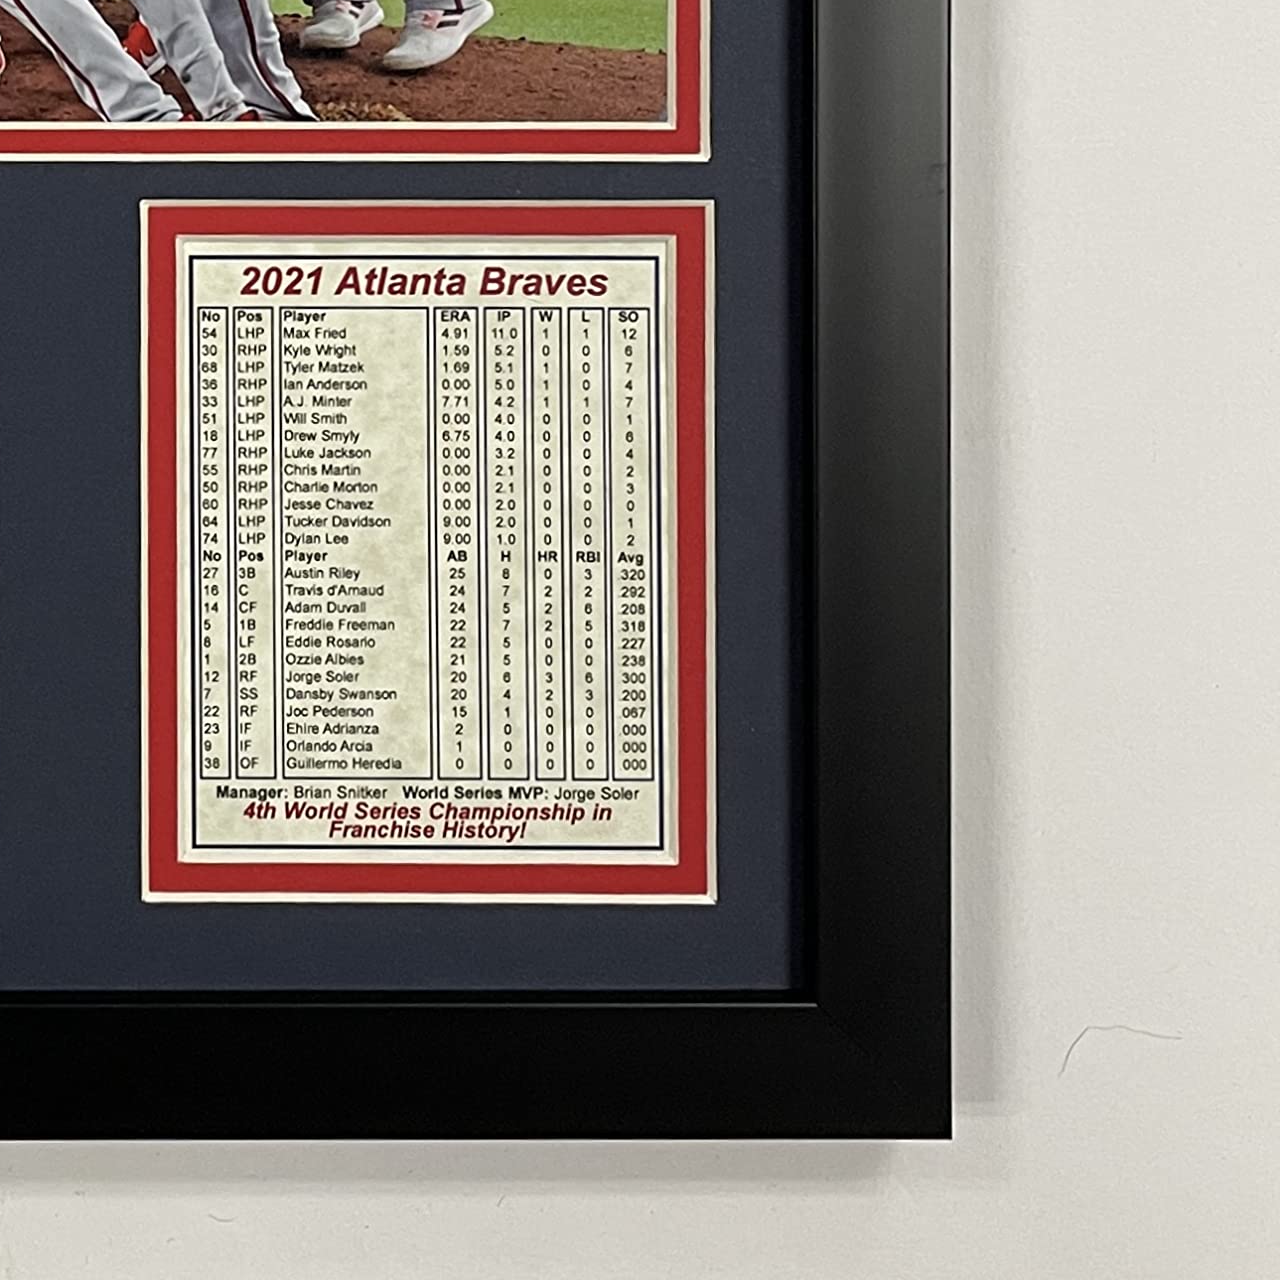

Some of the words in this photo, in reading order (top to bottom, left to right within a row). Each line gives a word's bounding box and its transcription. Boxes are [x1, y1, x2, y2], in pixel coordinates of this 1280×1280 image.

[240, 266, 323, 296] 2021
[333, 266, 467, 296] Atlanta
[479, 266, 609, 297] Braves
[201, 310, 221, 323] No
[237, 310, 263, 322] Pos
[283, 310, 327, 325] Player
[440, 309, 471, 323] ERA
[497, 310, 511, 322] IP
[538, 310, 554, 323] W
[581, 310, 591, 323] L
[618, 310, 639, 323] SO
[202, 327, 217, 339] 54
[237, 326, 265, 339] LHP
[283, 326, 310, 340] Max
[314, 327, 347, 340] Fried
[202, 344, 218, 357] 30
[237, 344, 267, 356] RHP
[283, 344, 311, 359] Kyle
[315, 344, 357, 359] Wright
[201, 361, 218, 373] 68
[237, 361, 265, 373] LHP
[283, 360, 315, 376] Tyler
[318, 360, 365, 374] Matzek
[202, 378, 218, 391] 36
[237, 378, 268, 390] RHP
[283, 378, 304, 391] Ian
[306, 378, 368, 391] Anderson
[202, 395, 218, 408] 33
[237, 395, 265, 408] LHP
[312, 395, 353, 408] Minter
[202, 412, 217, 425] 51
[237, 412, 266, 425] LHP
[283, 412, 307, 425] Will
[311, 412, 348, 425] Smith
[203, 429, 218, 442] 18
[237, 429, 265, 442] LHP
[283, 429, 318, 442] Drew
[321, 429, 360, 445] Smyly
[202, 446, 218, 459] 77
[237, 446, 268, 459] RHP
[284, 447, 315, 459] Luke
[318, 447, 372, 459] Jackson
[202, 464, 219, 476] 55
[237, 463, 268, 476] RHP
[284, 463, 318, 476] Chris
[321, 463, 361, 476] Martin
[202, 481, 219, 494] 50
[238, 480, 268, 493] RHP
[284, 480, 330, 494] Charlie
[333, 480, 378, 494] Morton
[202, 498, 219, 511] 60
[238, 498, 269, 510] RHP
[284, 498, 322, 511] Jesse
[325, 497, 374, 511] Chavez
[202, 515, 218, 528] 64
[238, 515, 266, 528] LHP
[284, 515, 329, 528] Tucker
[331, 515, 391, 528] Davidson
[203, 532, 218, 545] 74
[238, 532, 266, 545] LHP
[284, 532, 321, 547] Dylan
[325, 532, 349, 545] Lee
[202, 549, 222, 562] No
[238, 549, 265, 562] Pos
[284, 549, 329, 565] Player
[446, 549, 468, 563] AB
[500, 550, 512, 563] H
[538, 550, 558, 563] HR
[575, 550, 601, 563] RBI
[617, 551, 644, 567] Avg
[203, 566, 219, 579] 27
[238, 566, 256, 579] 3B
[284, 566, 324, 579] Austin
[328, 566, 361, 582] Riley
[449, 567, 466, 580] 25
[204, 584, 220, 597] 16
[238, 583, 249, 597] C
[285, 583, 324, 597] Travis
[449, 584, 466, 597] 24
[204, 601, 219, 613] 14
[238, 601, 257, 614] CF
[285, 601, 323, 614] Adam
[326, 601, 366, 614] Duvall
[449, 601, 466, 614] 24
[203, 618, 212, 631] 5
[239, 618, 256, 631] 1B
[285, 618, 334, 631] Freddie
[338, 618, 395, 631] Freeman
[450, 619, 467, 632] 22
[203, 635, 212, 649] 8
[239, 635, 255, 649] LF
[285, 635, 322, 648] Eddie
[326, 635, 376, 649] Rosario
[450, 636, 467, 649] 22
[204, 653, 210, 665] 1
[239, 652, 257, 666] 2B
[285, 652, 322, 666] Ozzie
[324, 653, 365, 666] Albies
[450, 653, 465, 666] 21
[204, 670, 220, 683] 12
[239, 670, 258, 682] RF
[285, 670, 322, 685] Jorge
[325, 670, 360, 683] Soler
[450, 670, 467, 684] 20
[204, 687, 212, 700] 7
[239, 687, 259, 700] SS
[285, 687, 334, 703] Dansby
[339, 687, 397, 701] Swanson
[450, 688, 468, 701] 20
[203, 705, 220, 718] 22
[239, 704, 258, 717] RF
[285, 705, 309, 718] Joc
[312, 704, 374, 718] Pederson
[452, 705, 468, 718] 15
[204, 722, 220, 735] 23
[239, 722, 252, 734] IF
[286, 722, 320, 735] Ehire
[322, 722, 380, 735] Adrianza
[203, 739, 212, 752] 9
[239, 739, 252, 752] IF
[286, 739, 338, 753] Orlando
[339, 739, 373, 753] Arcia
[204, 757, 220, 770] 38
[239, 756, 259, 770] OF
[286, 756, 348, 770] Guillermo
[352, 757, 402, 770] Heredia
[216, 785, 288, 802] Manager:
[293, 785, 332, 799] Brian
[336, 785, 388, 800] Snitker
[401, 785, 449, 800] World
[453, 785, 503, 800] Series
[508, 786, 549, 800] MVP:
[553, 786, 596, 803] Jorge
[600, 786, 640, 801] Soler
[243, 801, 277, 820] 4th
[284, 801, 349, 820] World
[354, 801, 422, 820] Series
[429, 801, 586, 822] Championship
[592, 802, 613, 821] in
[328, 820, 435, 839] Franchise
[442, 820, 527, 842] History!
